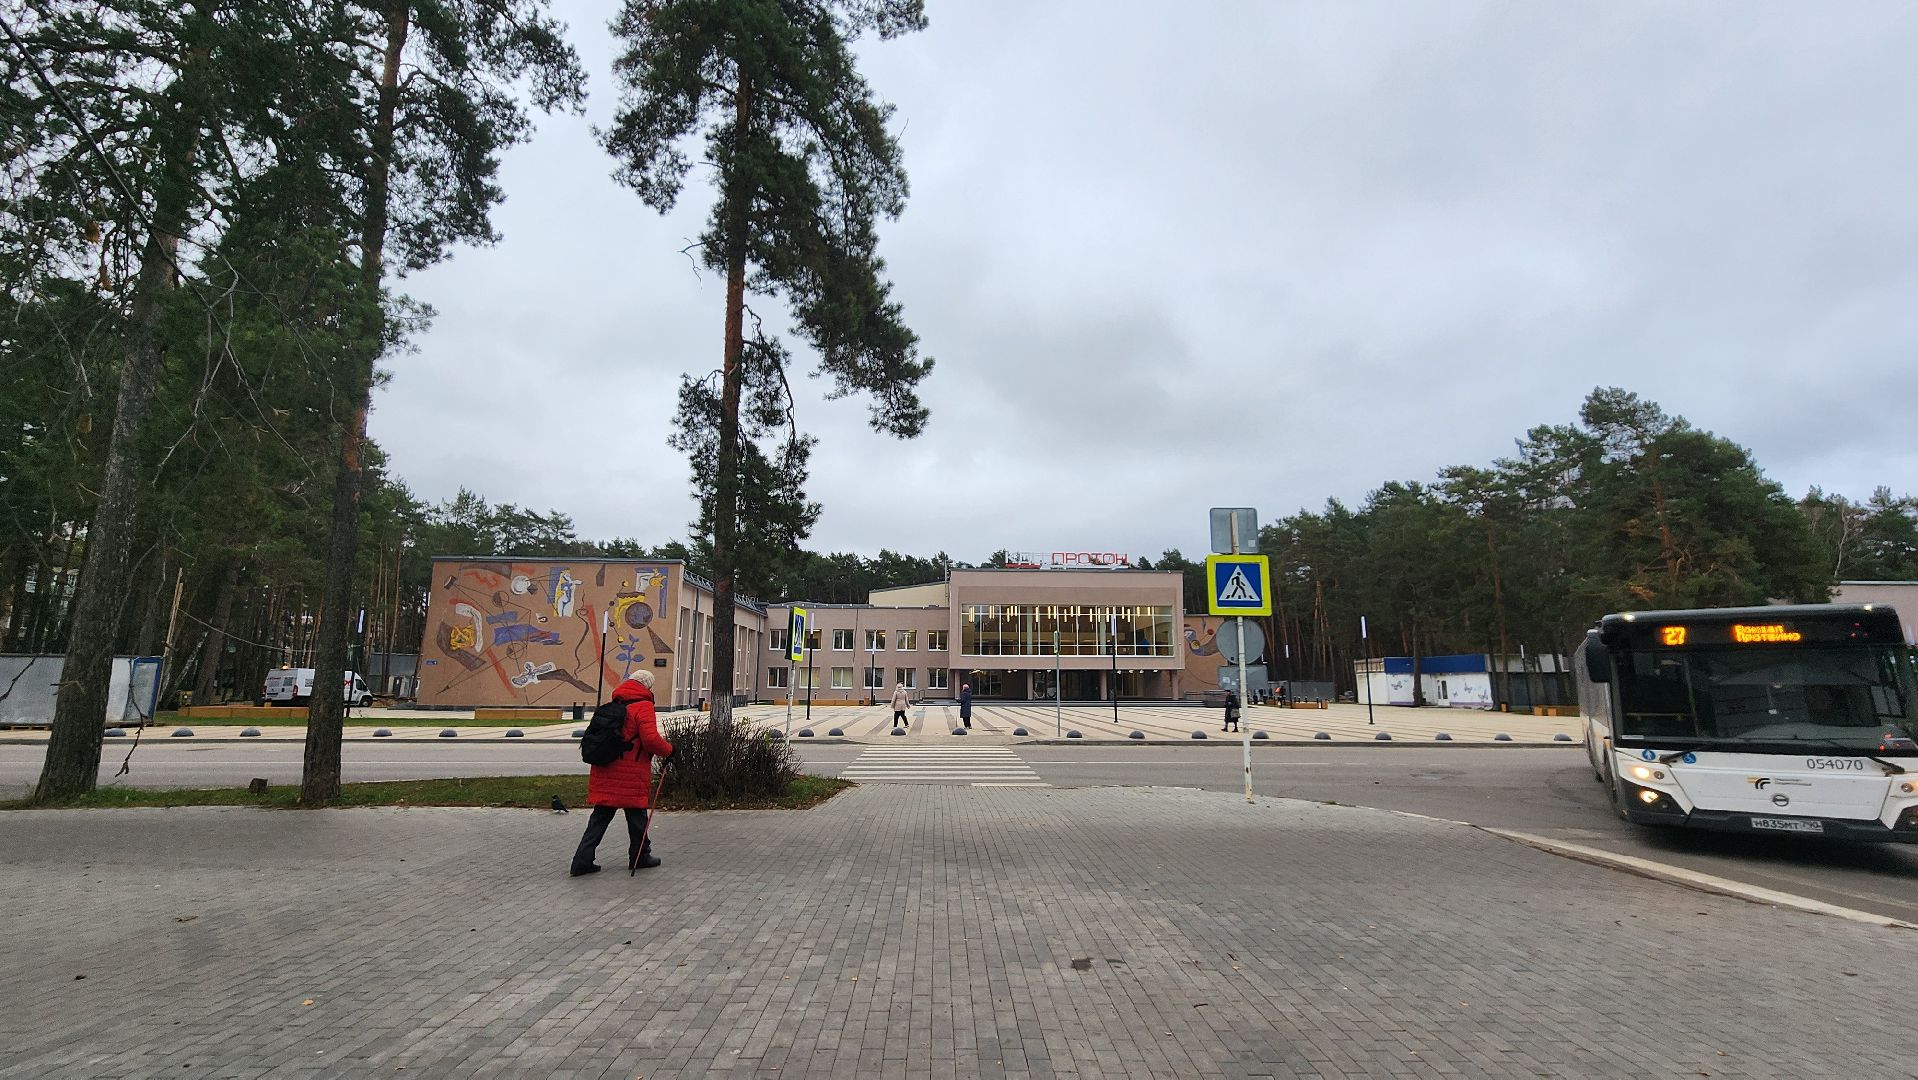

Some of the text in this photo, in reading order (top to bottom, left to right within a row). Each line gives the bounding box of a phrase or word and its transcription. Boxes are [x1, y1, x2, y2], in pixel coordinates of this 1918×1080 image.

[1051, 552, 1128, 565] ПРОТОН
[1664, 626, 1686, 646] 27
[1735, 632, 1801, 643] Протвино
[1806, 758, 1864, 771] 054070
